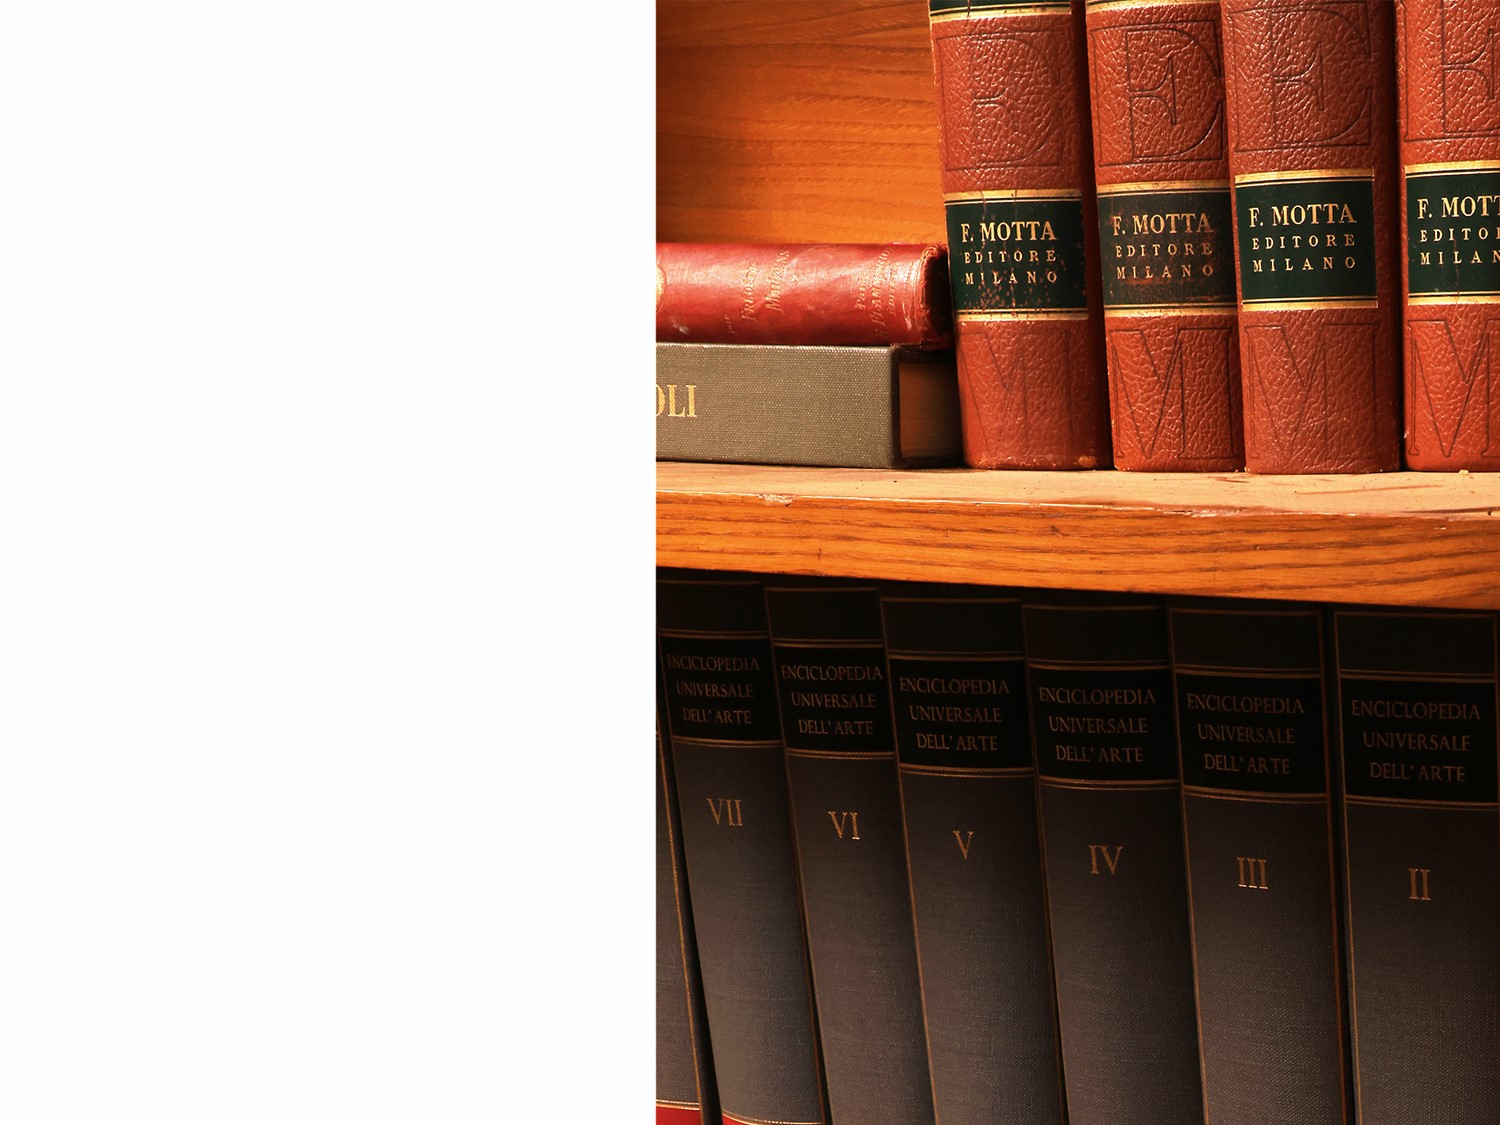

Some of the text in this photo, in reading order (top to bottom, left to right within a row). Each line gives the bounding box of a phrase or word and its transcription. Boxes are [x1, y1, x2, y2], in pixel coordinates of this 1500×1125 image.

[1248, 203, 1357, 228] F. MOTTA
[1417, 198, 1434, 220] F.
[961, 221, 1057, 242] F. MOTTA
[1113, 212, 1214, 236] F. MOTTA
[1115, 242, 1213, 258] EDITORE
[1251, 233, 1355, 251] EDITORE
[964, 249, 1056, 264] EDITORE
[1253, 256, 1356, 273] MILANO
[965, 271, 1057, 285] MILANO
[1116, 264, 1214, 280] MILANO
[667, 654, 760, 672] ENCICLOPEDIA
[781, 664, 883, 682] ENCICLOPEDIA
[676, 683, 754, 698] UNIVERSALE
[900, 677, 1010, 695] ENCICLOPEDIA
[791, 692, 876, 709] UNIVERSALE
[1038, 687, 1156, 705] ENCICLOPEDIA
[1187, 693, 1305, 715] ENCICLOPEDIA
[909, 705, 1003, 723] UNIVERSALE
[1351, 700, 1482, 721] ENCICLOPEDIA
[1048, 716, 1148, 734] UNIVERSALE
[1197, 723, 1295, 744] UNIVERSALE
[1363, 731, 1471, 752] UNIVERSALE
[707, 797, 743, 827] VII
[828, 811, 860, 840] VI
[953, 830, 974, 859] V
[1088, 844, 1123, 875] IV
[1237, 857, 1269, 890] III
[1408, 868, 1431, 900] II
